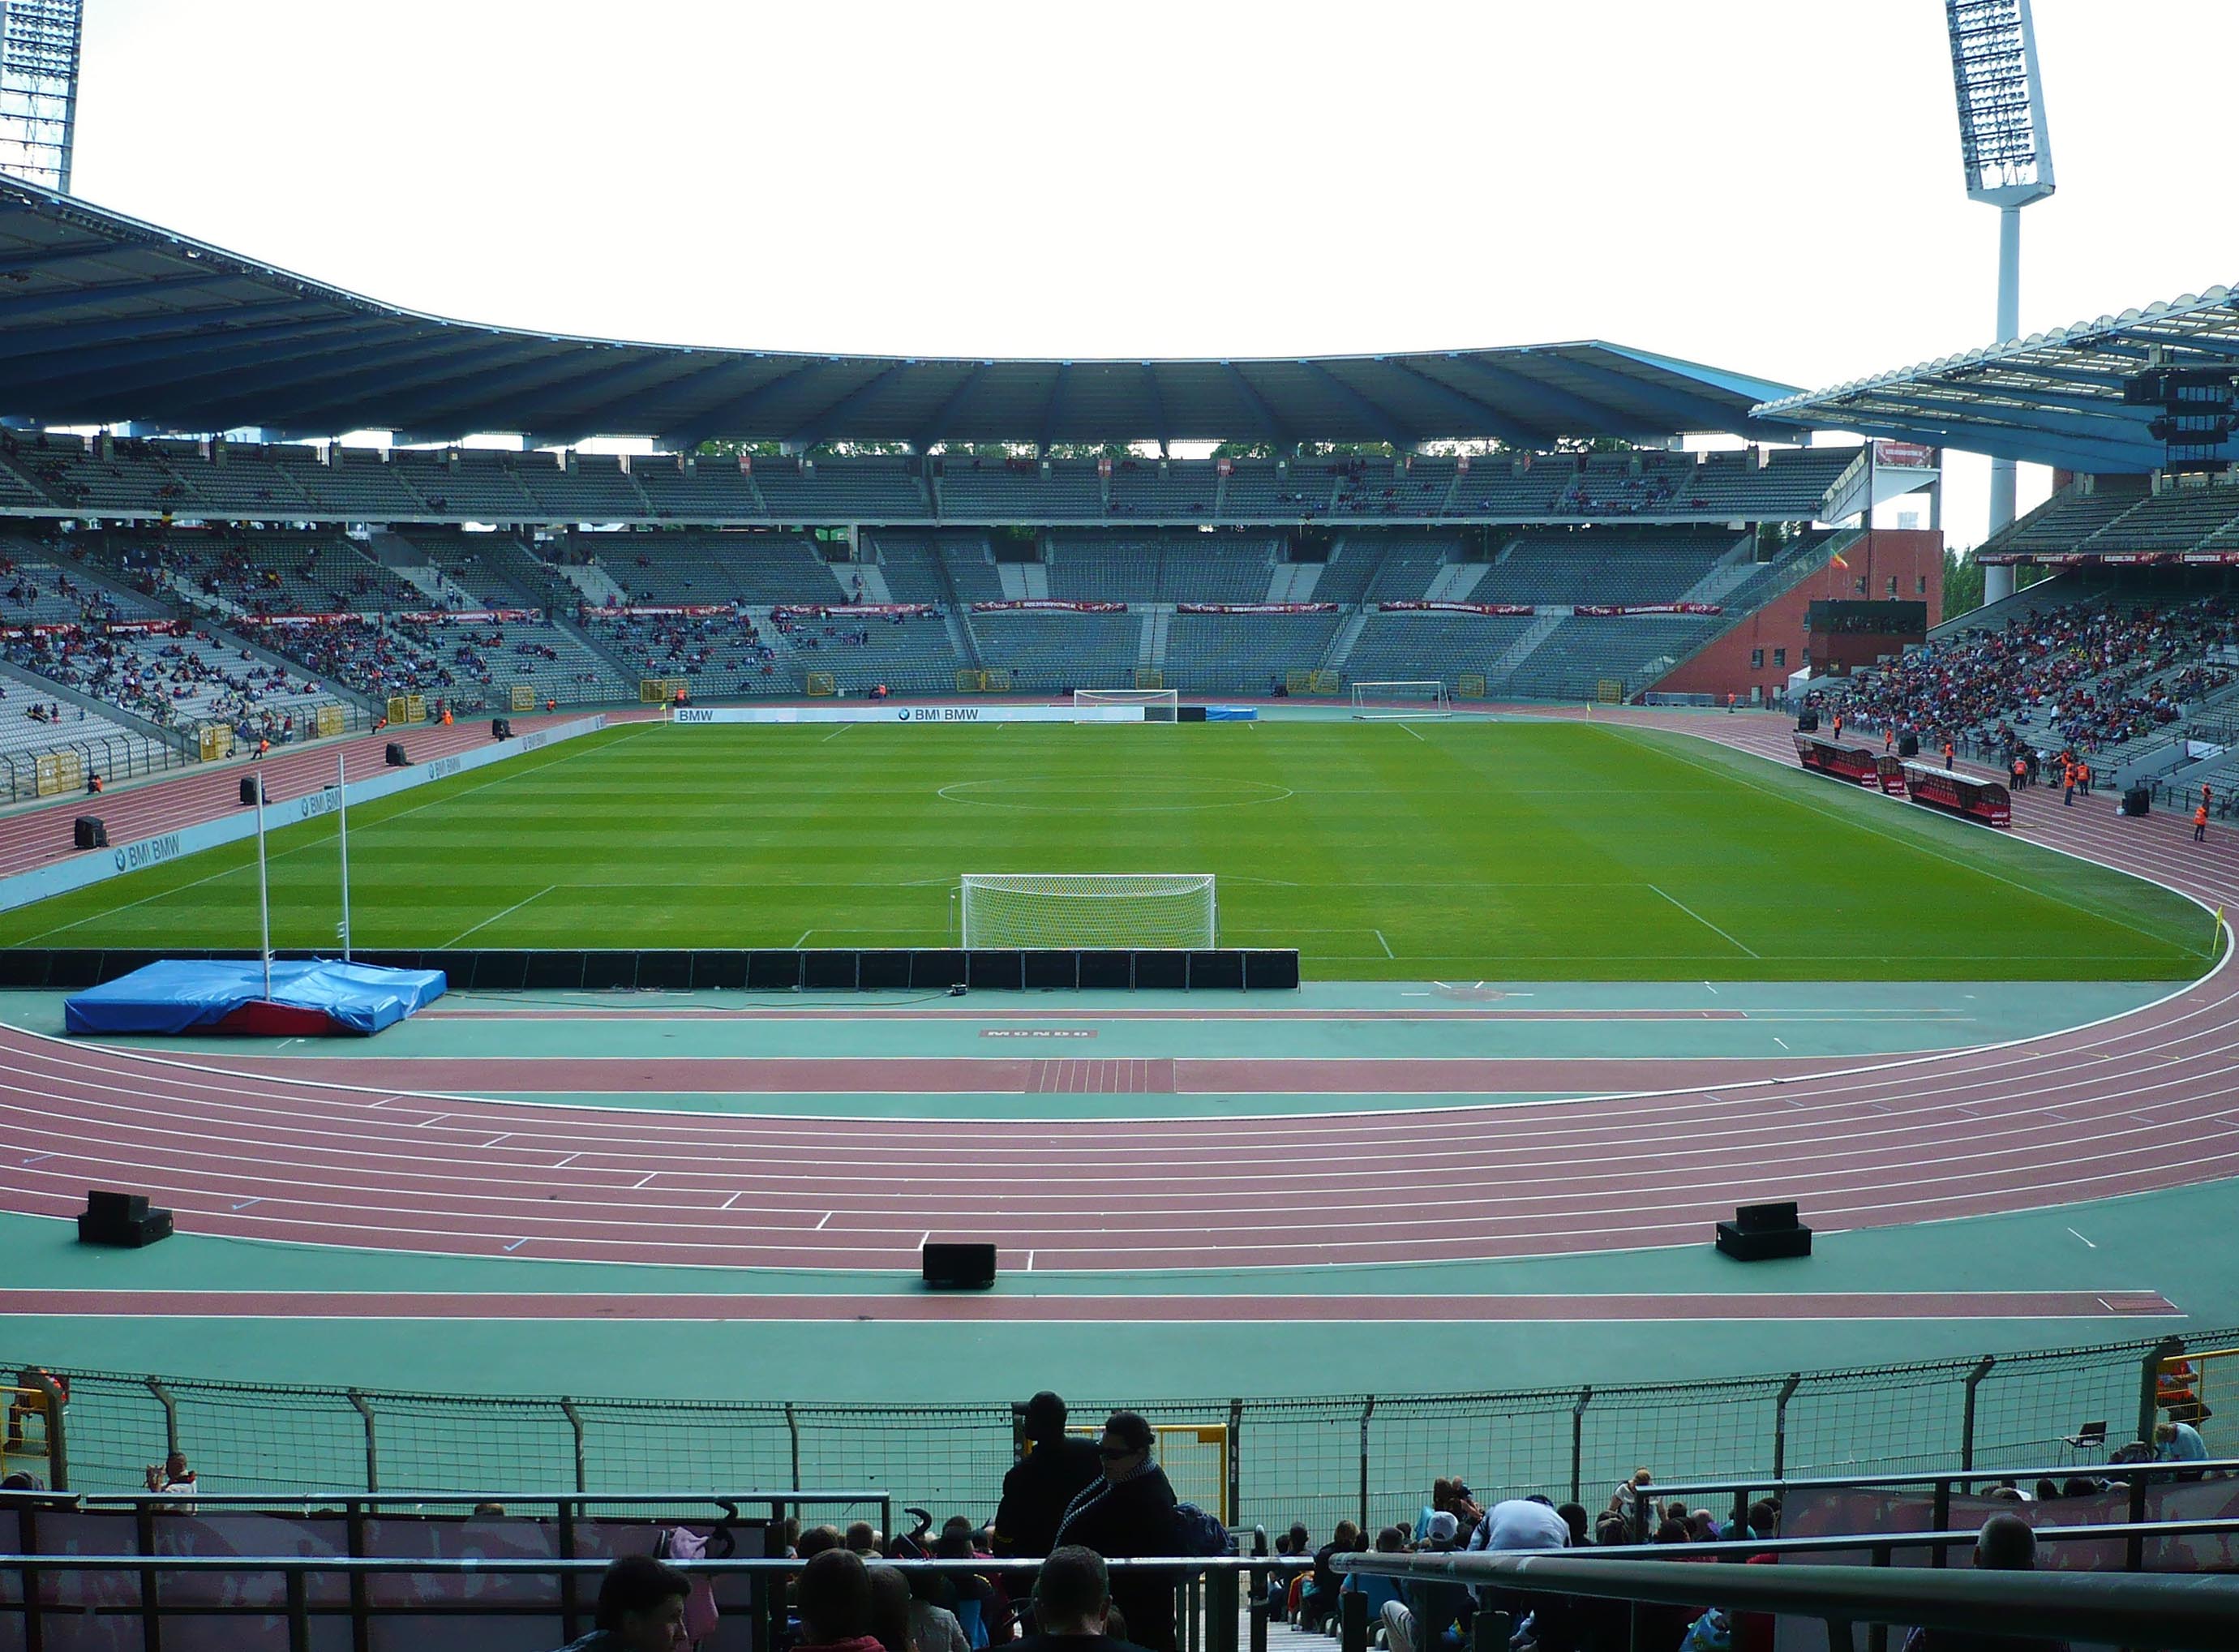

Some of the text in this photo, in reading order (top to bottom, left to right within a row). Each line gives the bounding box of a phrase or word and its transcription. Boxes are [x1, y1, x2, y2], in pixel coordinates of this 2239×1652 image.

[680, 710, 714, 721] BMW
[945, 709, 979, 720] BMW
[152, 835, 180, 860] BMW
